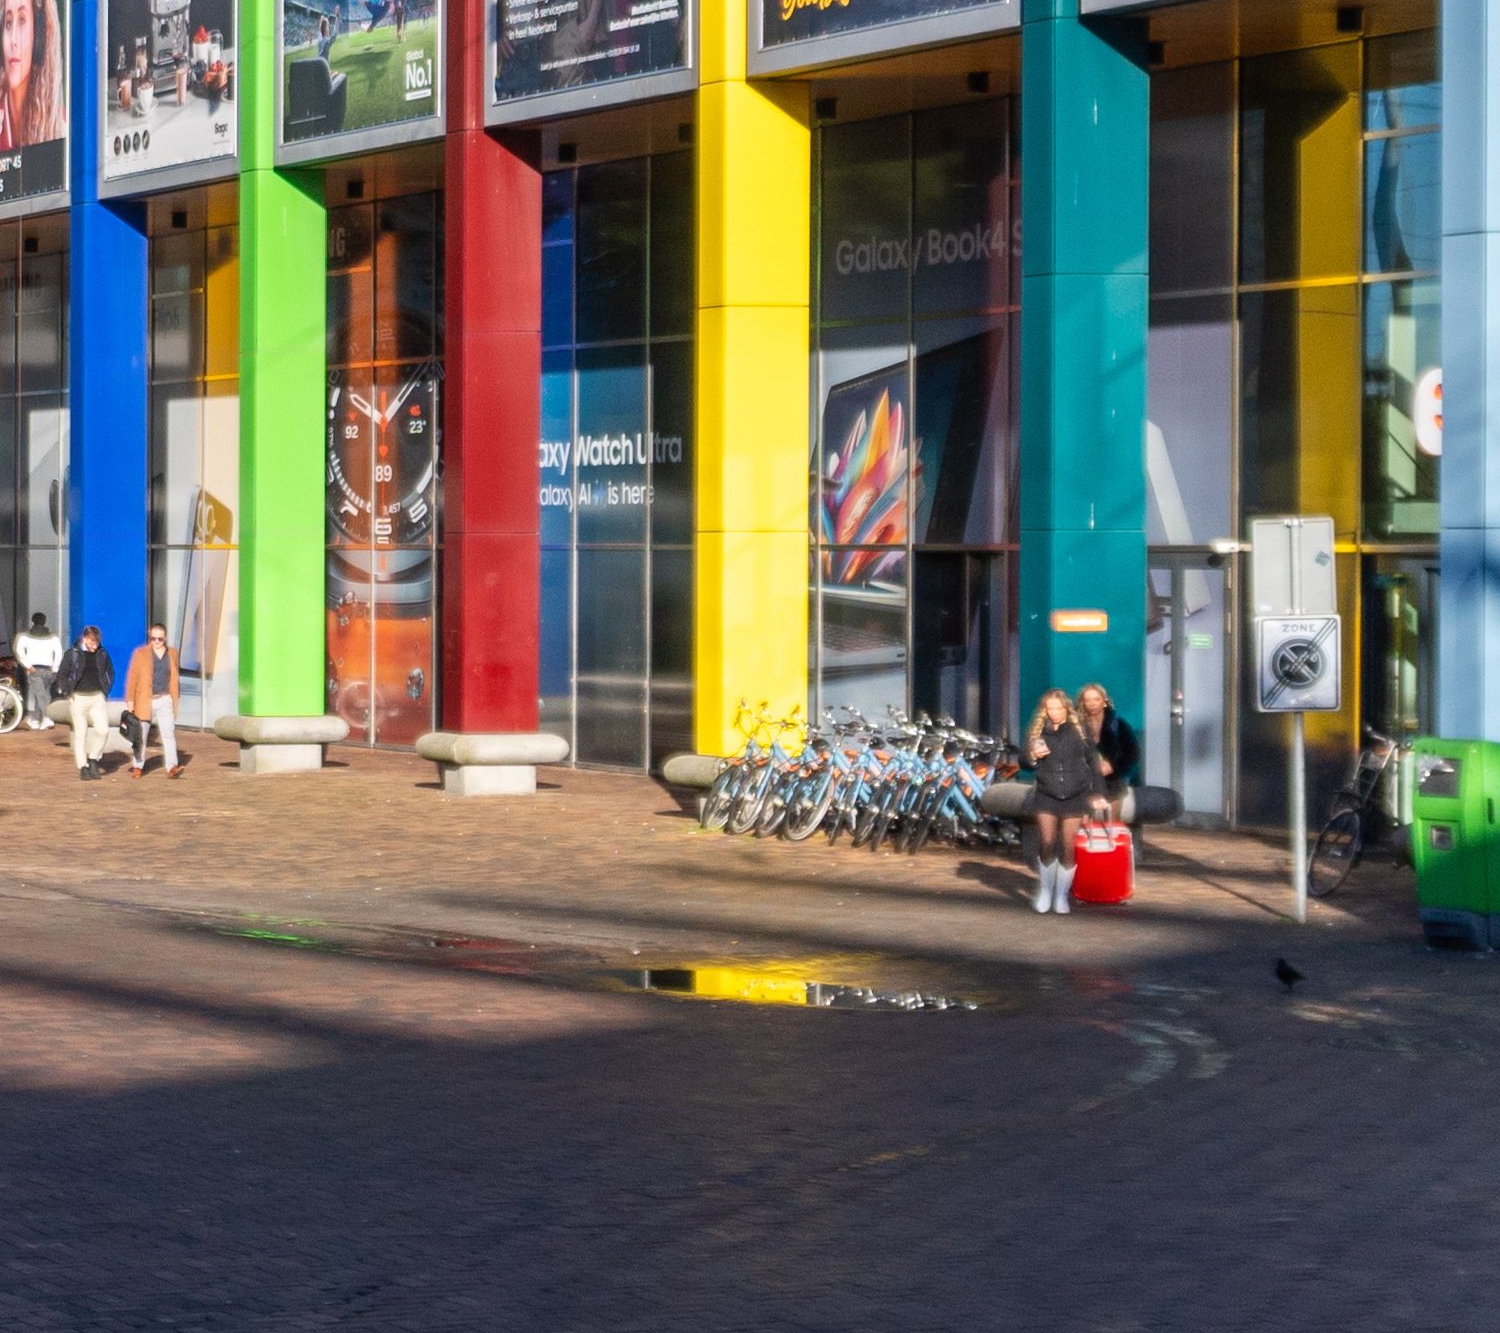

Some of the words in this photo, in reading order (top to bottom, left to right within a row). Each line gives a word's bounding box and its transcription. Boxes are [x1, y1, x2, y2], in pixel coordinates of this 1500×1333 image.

[406, 58, 432, 90] No.1
[835, 235, 923, 276] Galaxy
[927, 219, 1007, 266] Book4
[345, 425, 359, 440] 92
[539, 438, 571, 475] axy
[576, 433, 634, 467] Watch
[375, 464, 393, 483] 89
[539, 484, 574, 513] alaxy
[607, 481, 619, 505] is
[1281, 623, 1317, 633] ZONE
